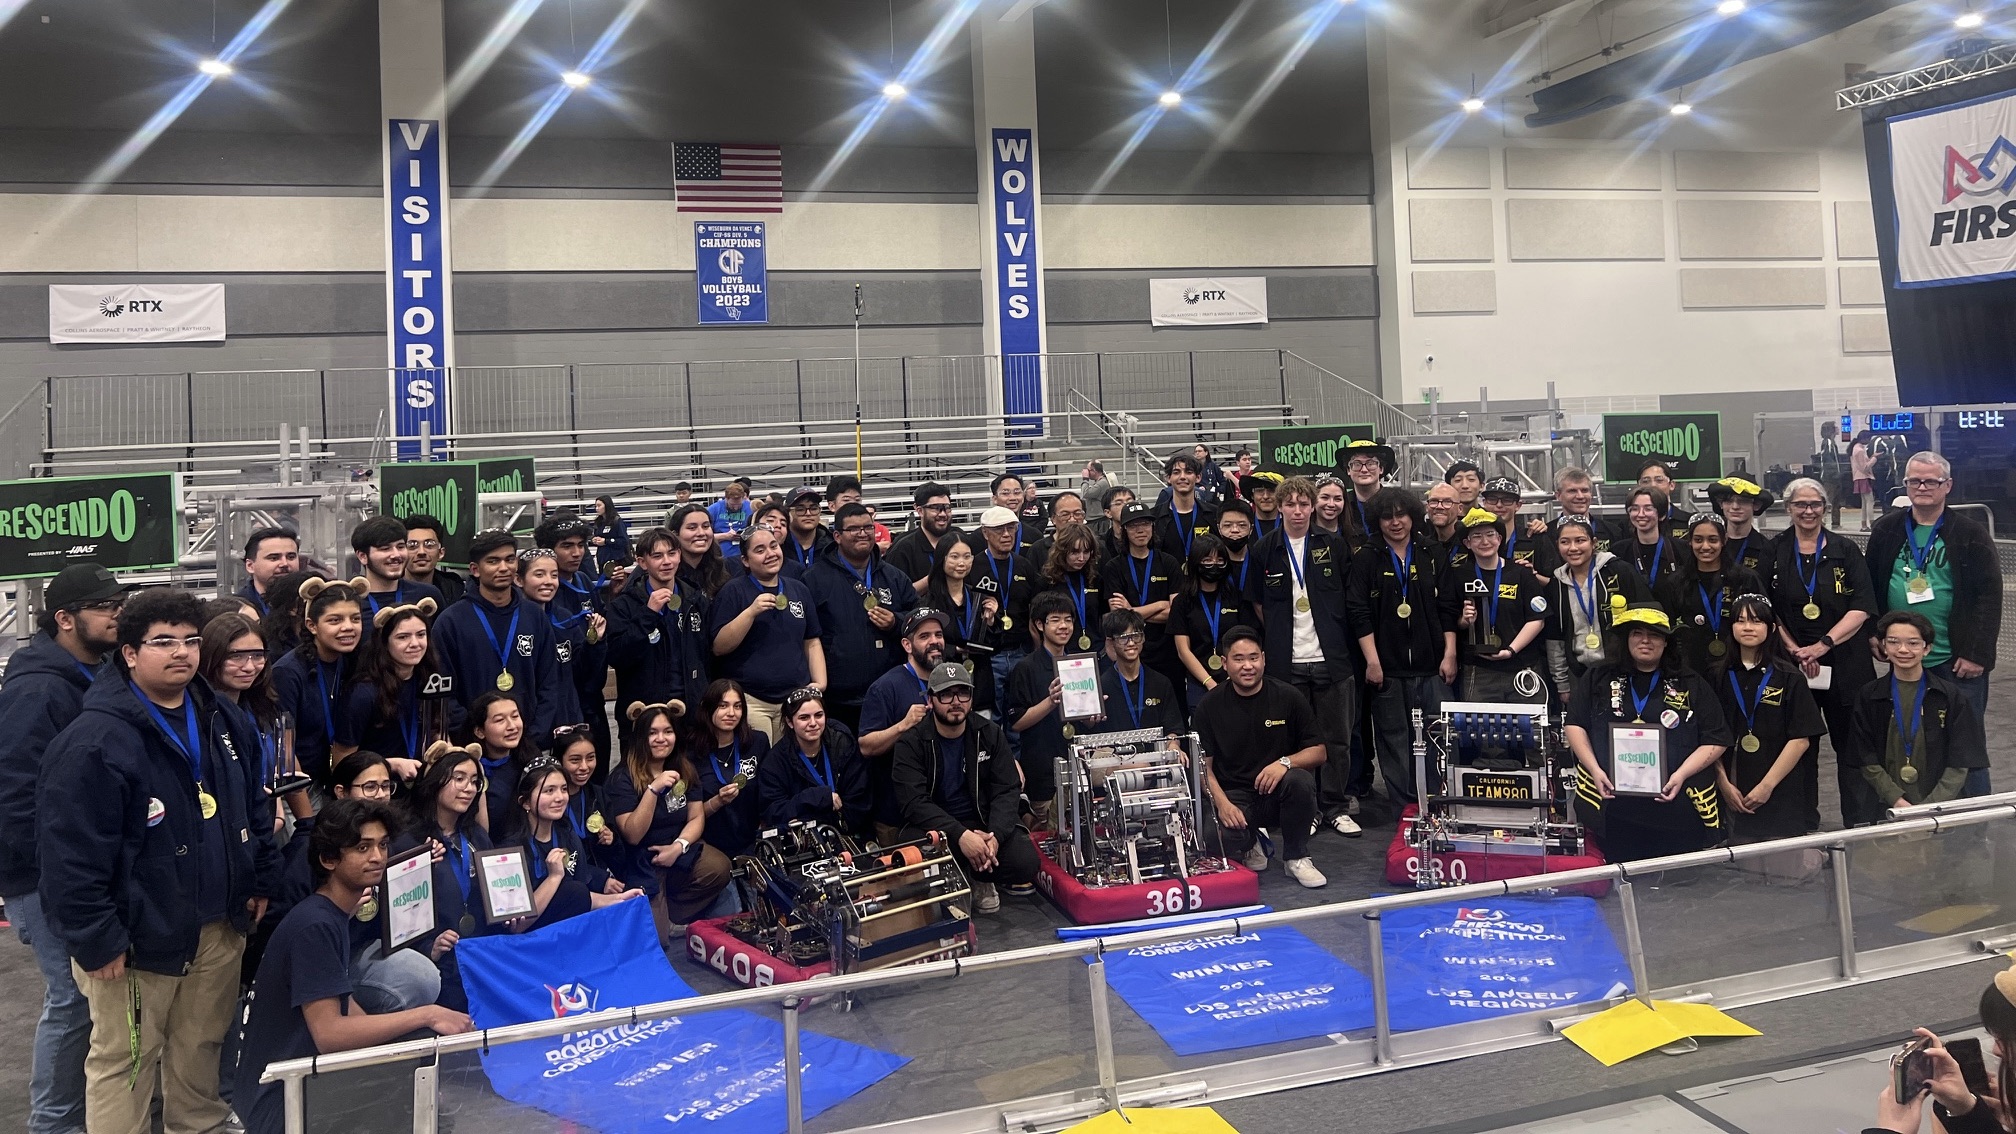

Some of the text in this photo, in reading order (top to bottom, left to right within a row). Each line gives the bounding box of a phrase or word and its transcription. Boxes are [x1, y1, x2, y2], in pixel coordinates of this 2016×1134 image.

[997, 138, 1030, 319] WOLVES
[700, 239, 762, 248] CHAMPIONS
[398, 123, 435, 408] VISITORS
[721, 276, 743, 284] BOYS
[702, 284, 762, 294] VOLLEYBALL
[1202, 290, 1226, 300] RTX
[129, 300, 163, 313] RTX
[715, 295, 750, 306] 2023
[1620, 422, 1699, 461] CRESCENDO
[393, 478, 458, 536] CRESCENDO
[65, 544, 98, 555] HAAS
[1617, 751, 1656, 767] CRESCENDO
[1479, 777, 1516, 785] CALIFORNIA
[1468, 784, 1529, 800] TEAM980
[491, 873, 522, 888] CRESCENDO
[392, 880, 429, 908] CRESCENDO
[1146, 884, 1203, 915] 368
[689, 935, 774, 988] 9408
